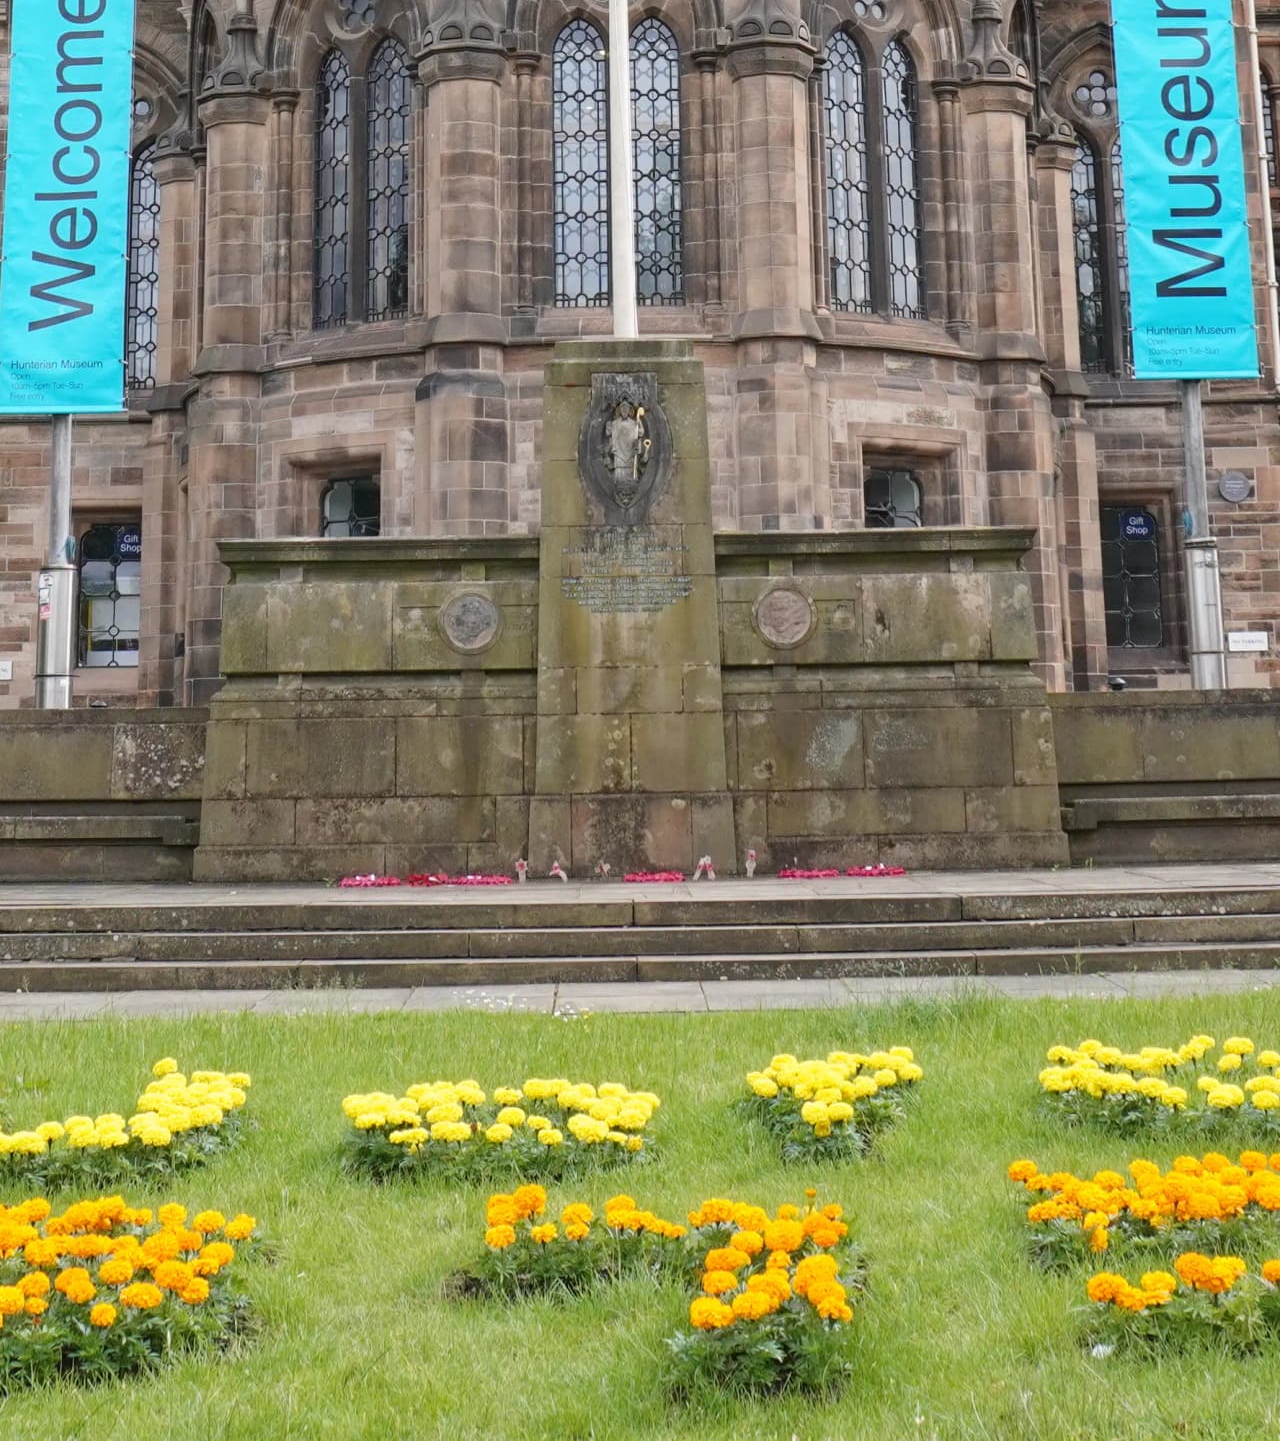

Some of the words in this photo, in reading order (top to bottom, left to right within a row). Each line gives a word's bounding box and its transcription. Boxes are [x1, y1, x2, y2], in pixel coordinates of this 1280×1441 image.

[1146, 325, 1192, 335] Hunterian
[1195, 325, 1237, 335] Museum
[10, 358, 58, 370] Hunterian
[60, 358, 104, 369] Museum
[1128, 516, 1144, 525] Gift
[1126, 525, 1149, 536] Shop
[123, 534, 138, 543] Gift
[120, 543, 141, 554] Shop
